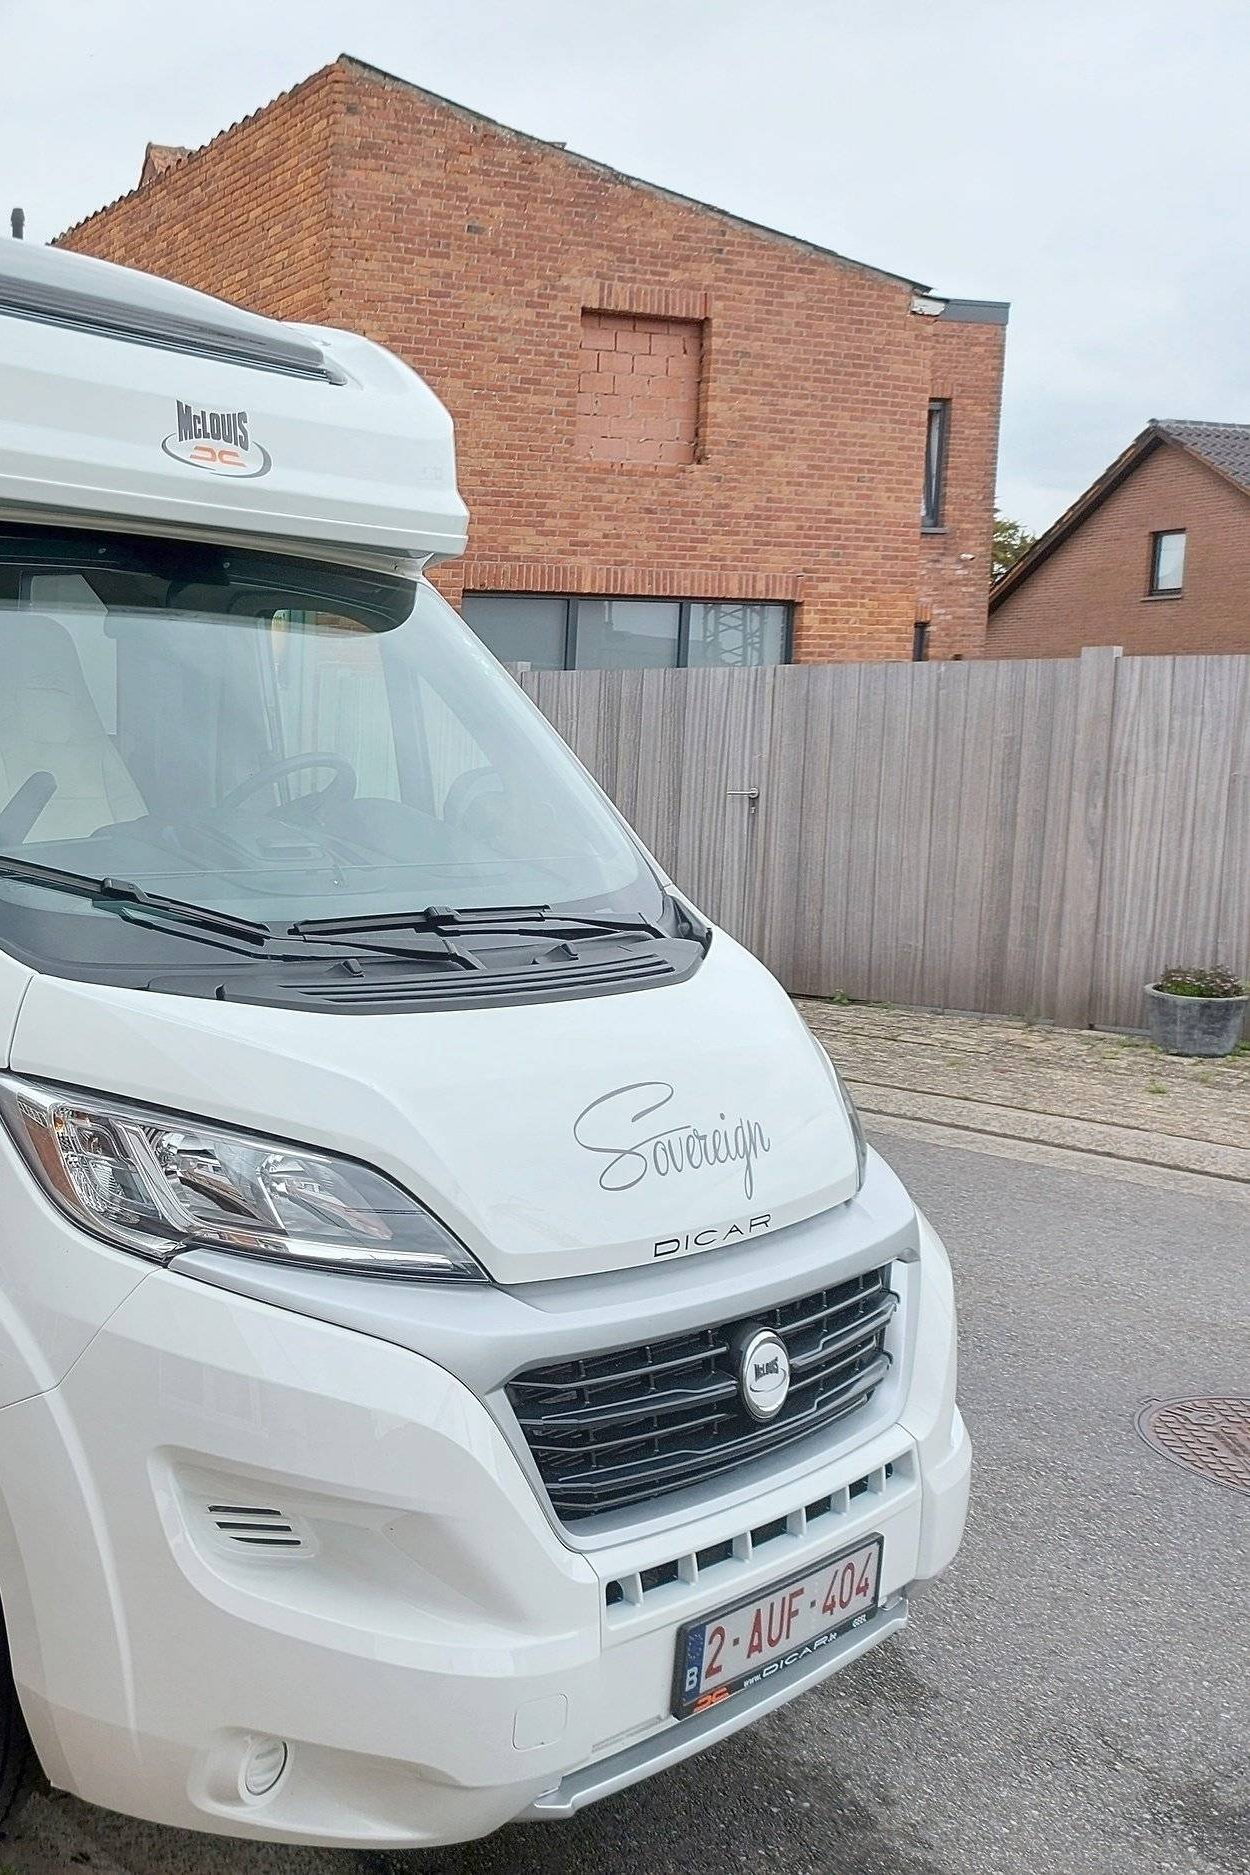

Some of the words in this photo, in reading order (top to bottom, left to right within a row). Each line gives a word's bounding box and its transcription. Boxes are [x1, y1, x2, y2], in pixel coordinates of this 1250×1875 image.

[574, 1081, 771, 1200] Sovereign
[653, 1213, 771, 1257] DICAR
[684, 1666, 699, 1691] B
